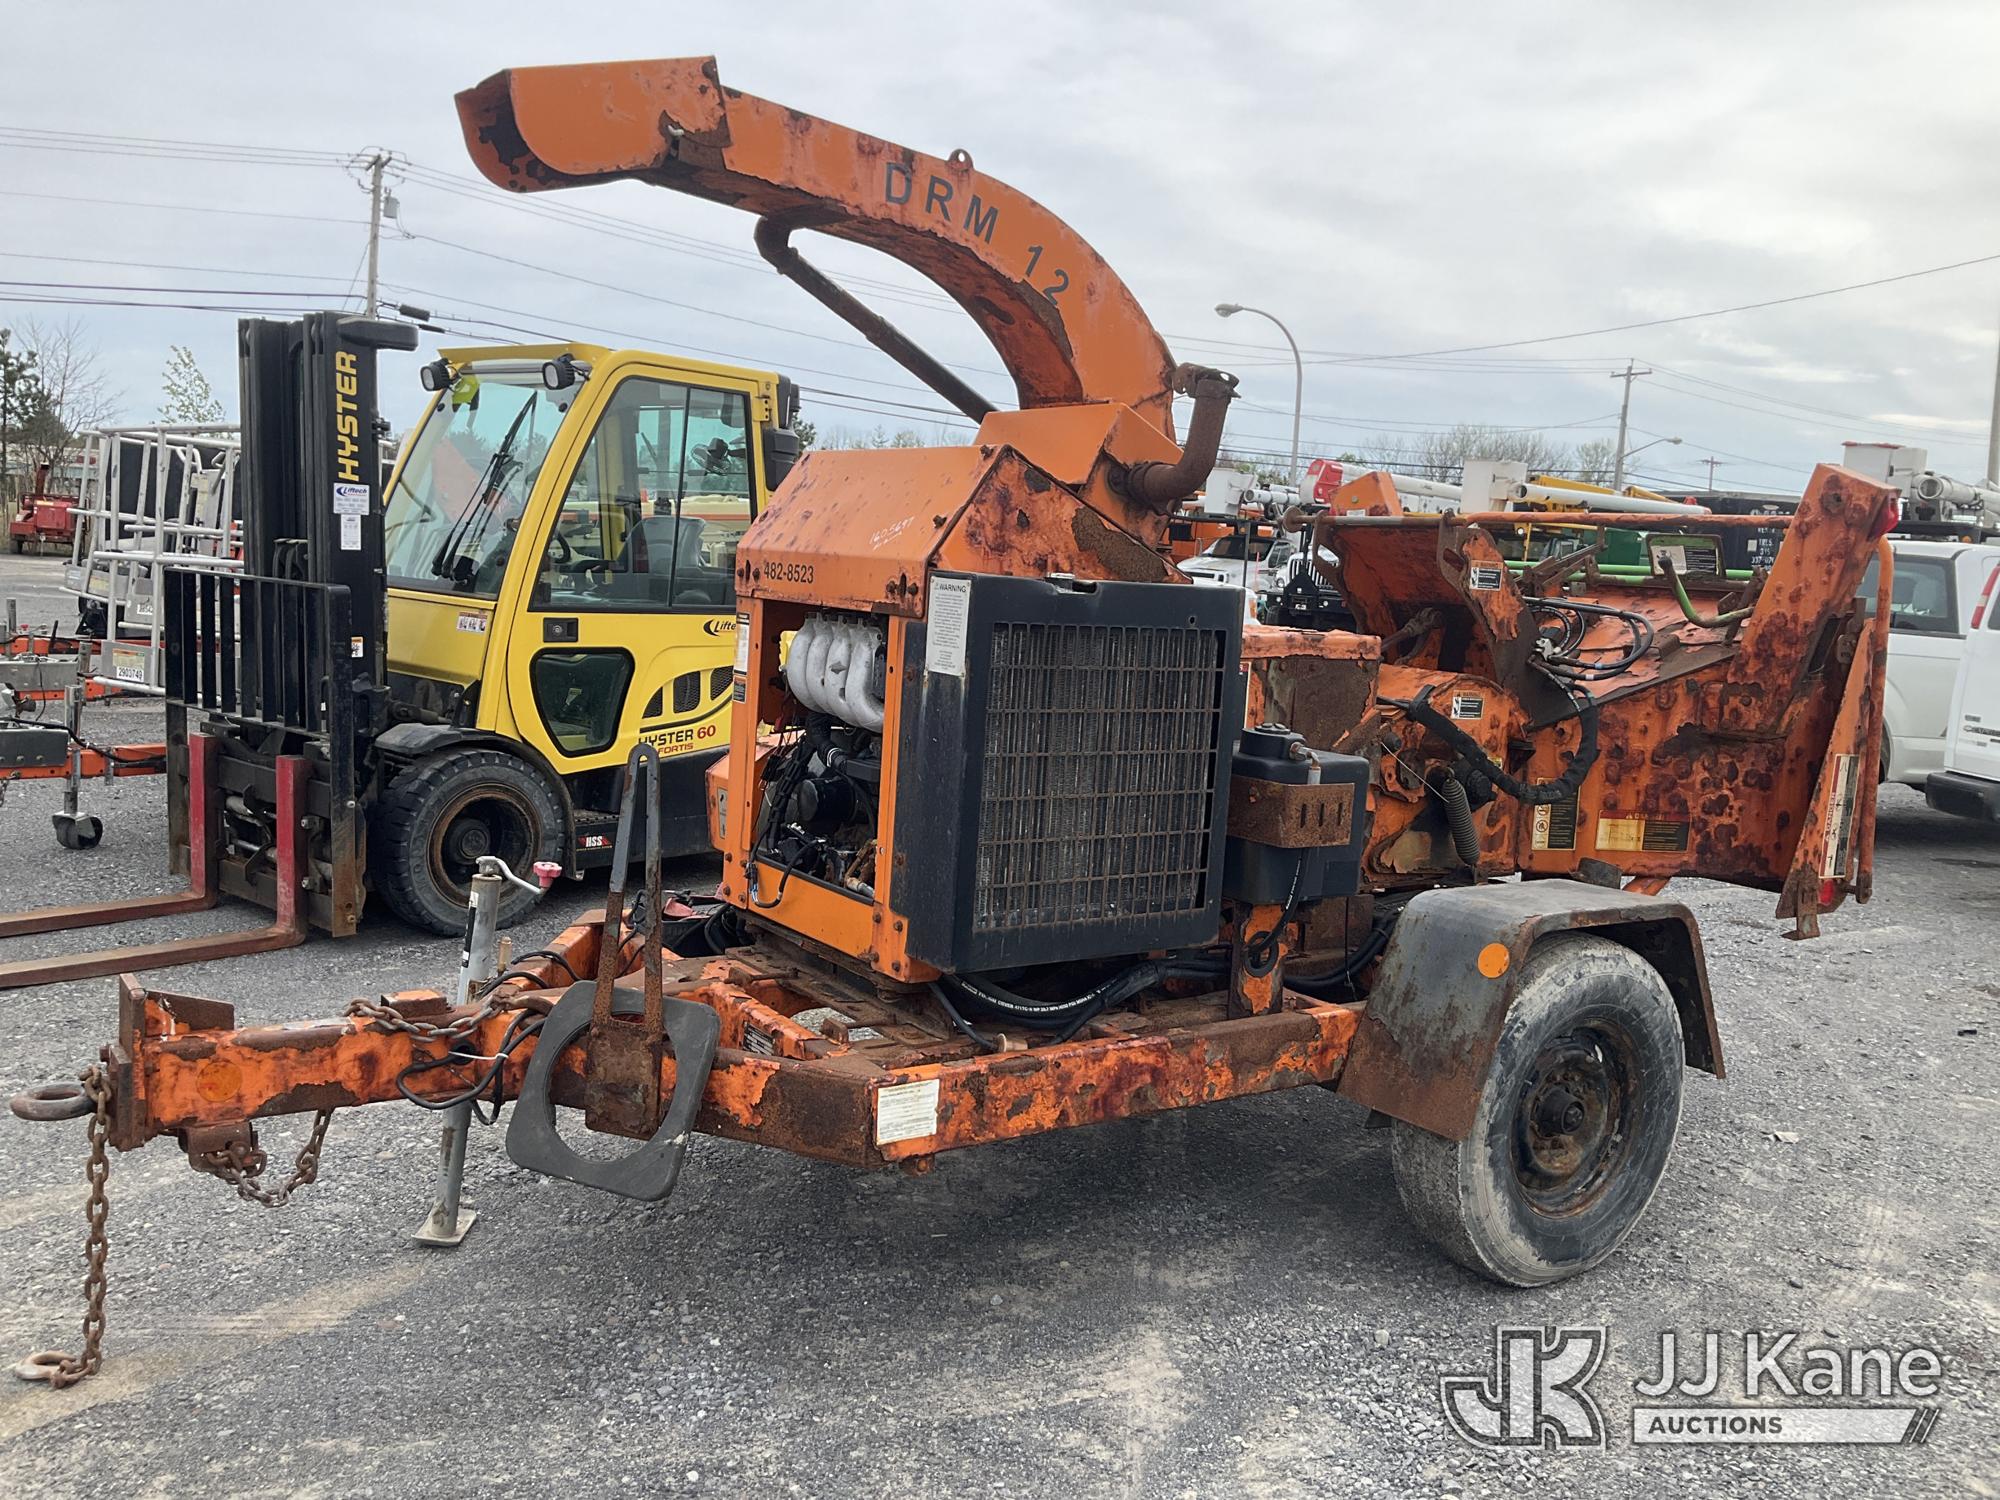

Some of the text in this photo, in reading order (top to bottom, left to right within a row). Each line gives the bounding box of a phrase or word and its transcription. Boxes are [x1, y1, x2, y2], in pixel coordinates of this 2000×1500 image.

[885, 162, 1070, 306] DRM 12
[335, 350, 360, 482] HYSTER
[763, 562, 815, 584] 482-8523
[939, 583, 967, 593] WARNING
[696, 724, 716, 740] 60
[658, 742, 694, 754] FORTIS
[585, 836, 603, 848] HSS
